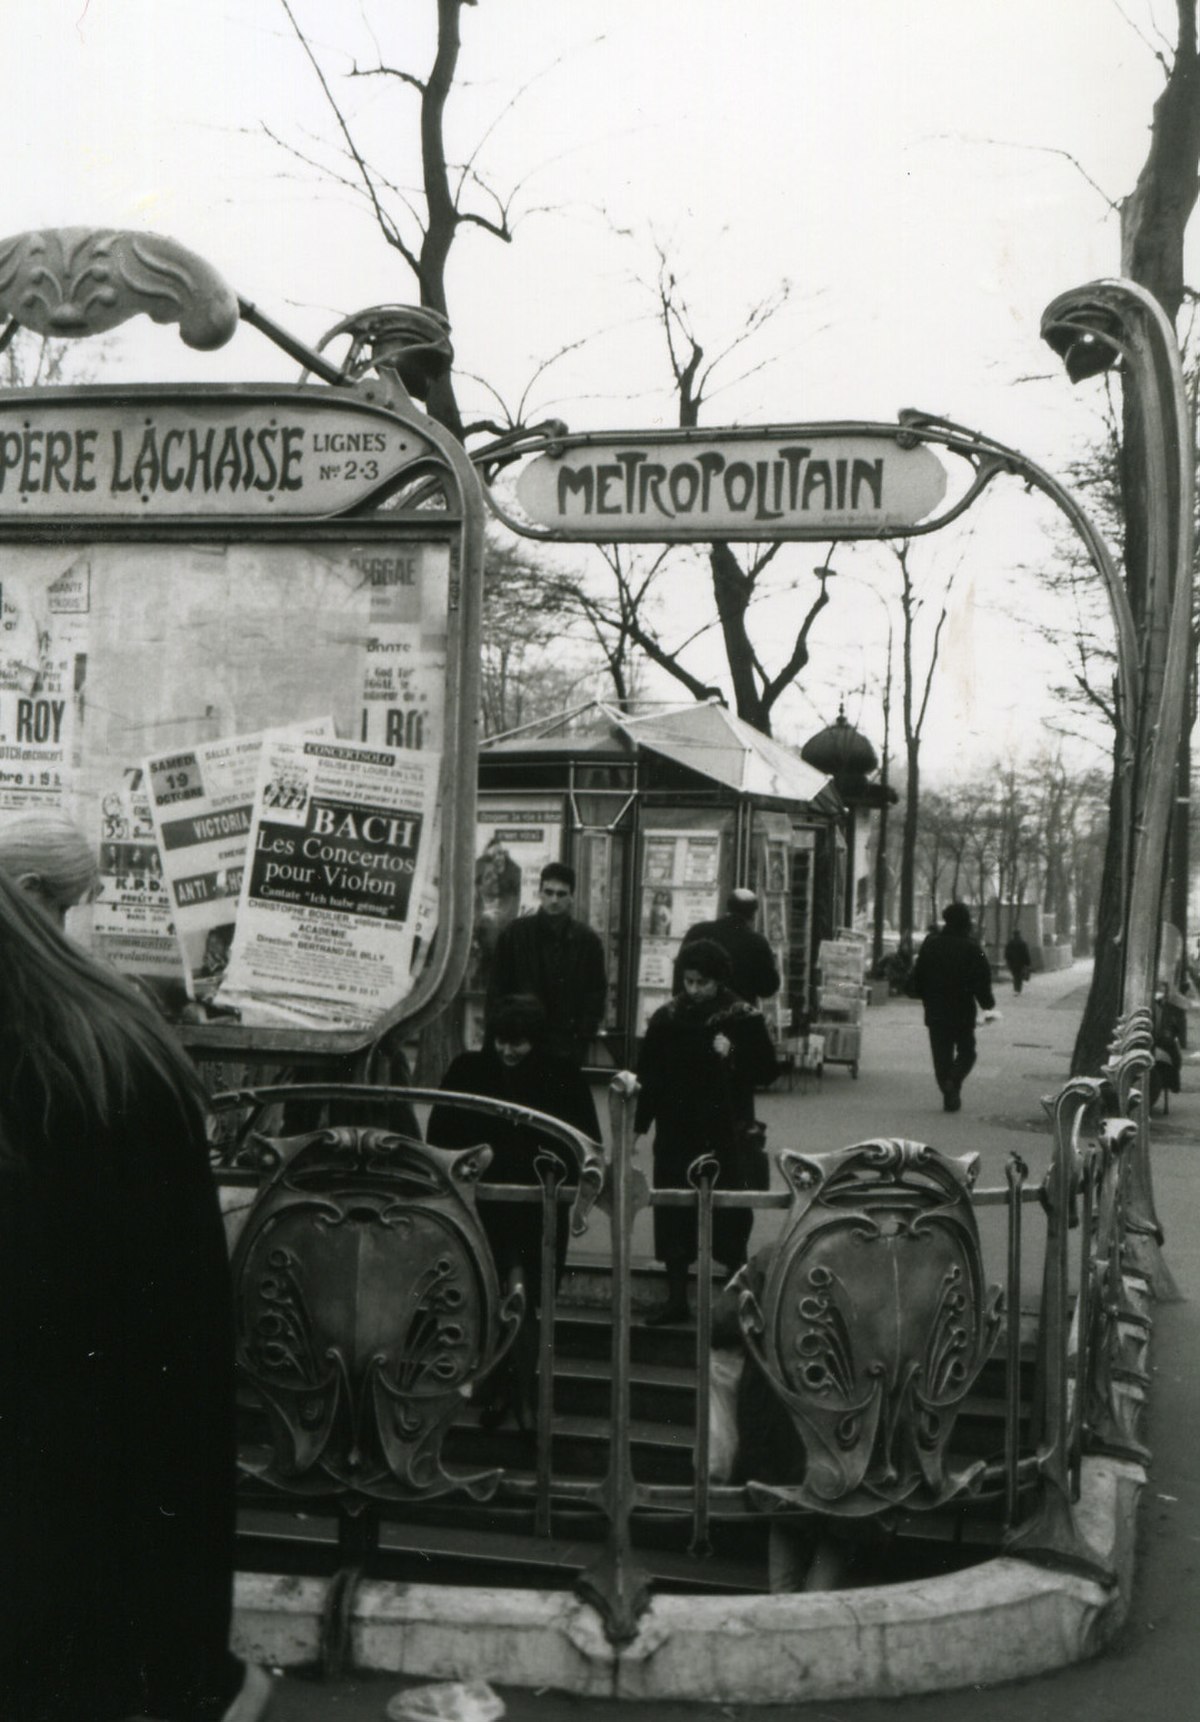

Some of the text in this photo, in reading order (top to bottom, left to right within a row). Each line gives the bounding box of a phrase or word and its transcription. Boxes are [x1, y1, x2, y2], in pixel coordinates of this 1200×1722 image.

[313, 433, 386, 452] LIGNES
[557, 446, 884, 520] METROPOLITAIN
[16, 698, 66, 744] ROY
[385, 708, 430, 750] RO
[150, 754, 196, 774] SAMEDI
[166, 772, 189, 789] 19
[156, 786, 204, 806] OCTOBRE
[193, 810, 249, 839] VICTORIA
[312, 808, 416, 848] BACH
[257, 830, 415, 874] Les Concertos
[178, 880, 208, 904] ANTI
[265, 862, 397, 897] pour Violon
[248, 898, 305, 916] CHRISTOPHE
[260, 884, 301, 900] Cantate
[330, 895, 354, 910] habe
